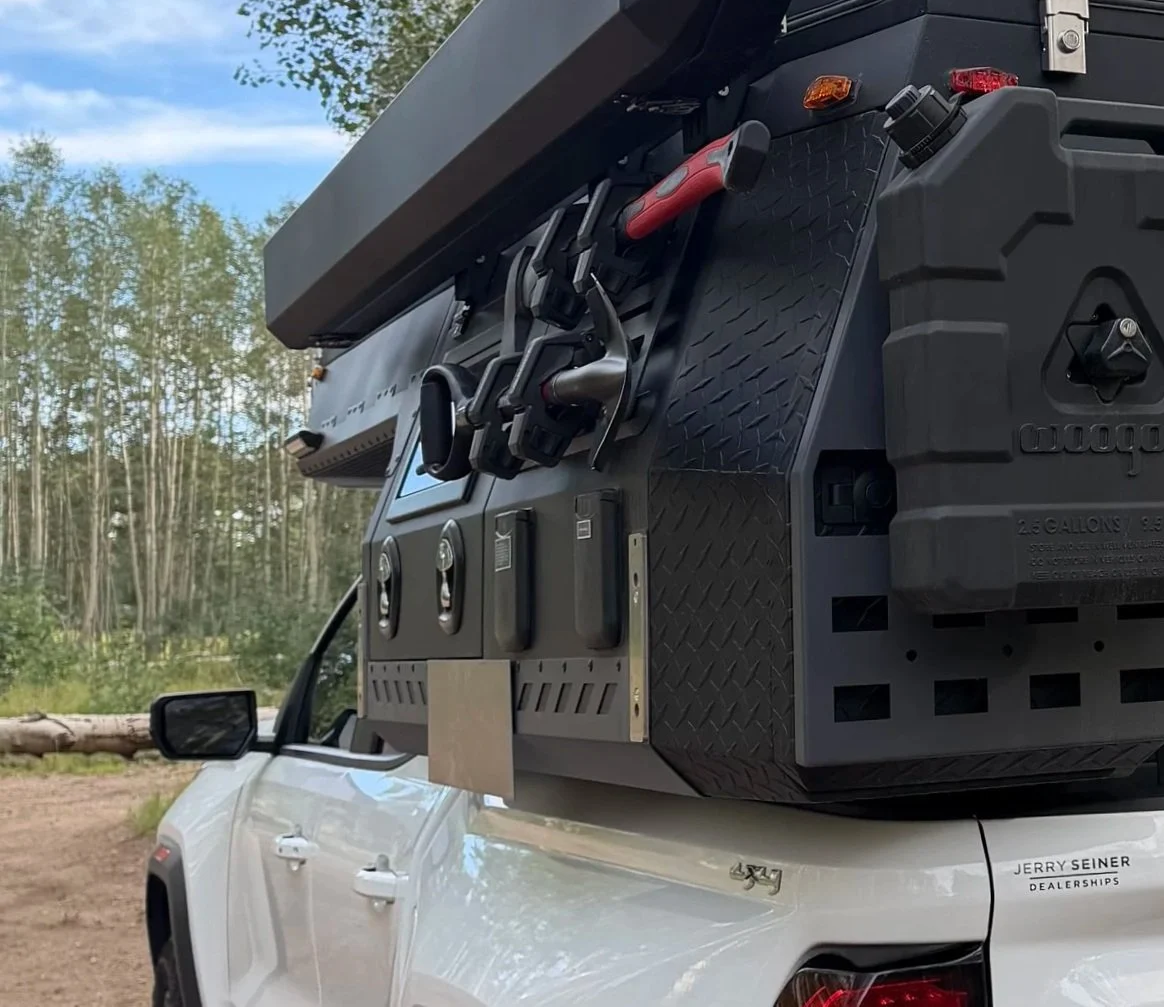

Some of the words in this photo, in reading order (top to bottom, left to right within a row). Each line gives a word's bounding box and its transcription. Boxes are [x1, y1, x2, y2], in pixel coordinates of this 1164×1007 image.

[1044, 515, 1121, 535] GALLONS
[1014, 860, 1067, 875] JERRY
[1071, 855, 1131, 871] SEINER
[1029, 877, 1120, 892] DEALERSHIPS
